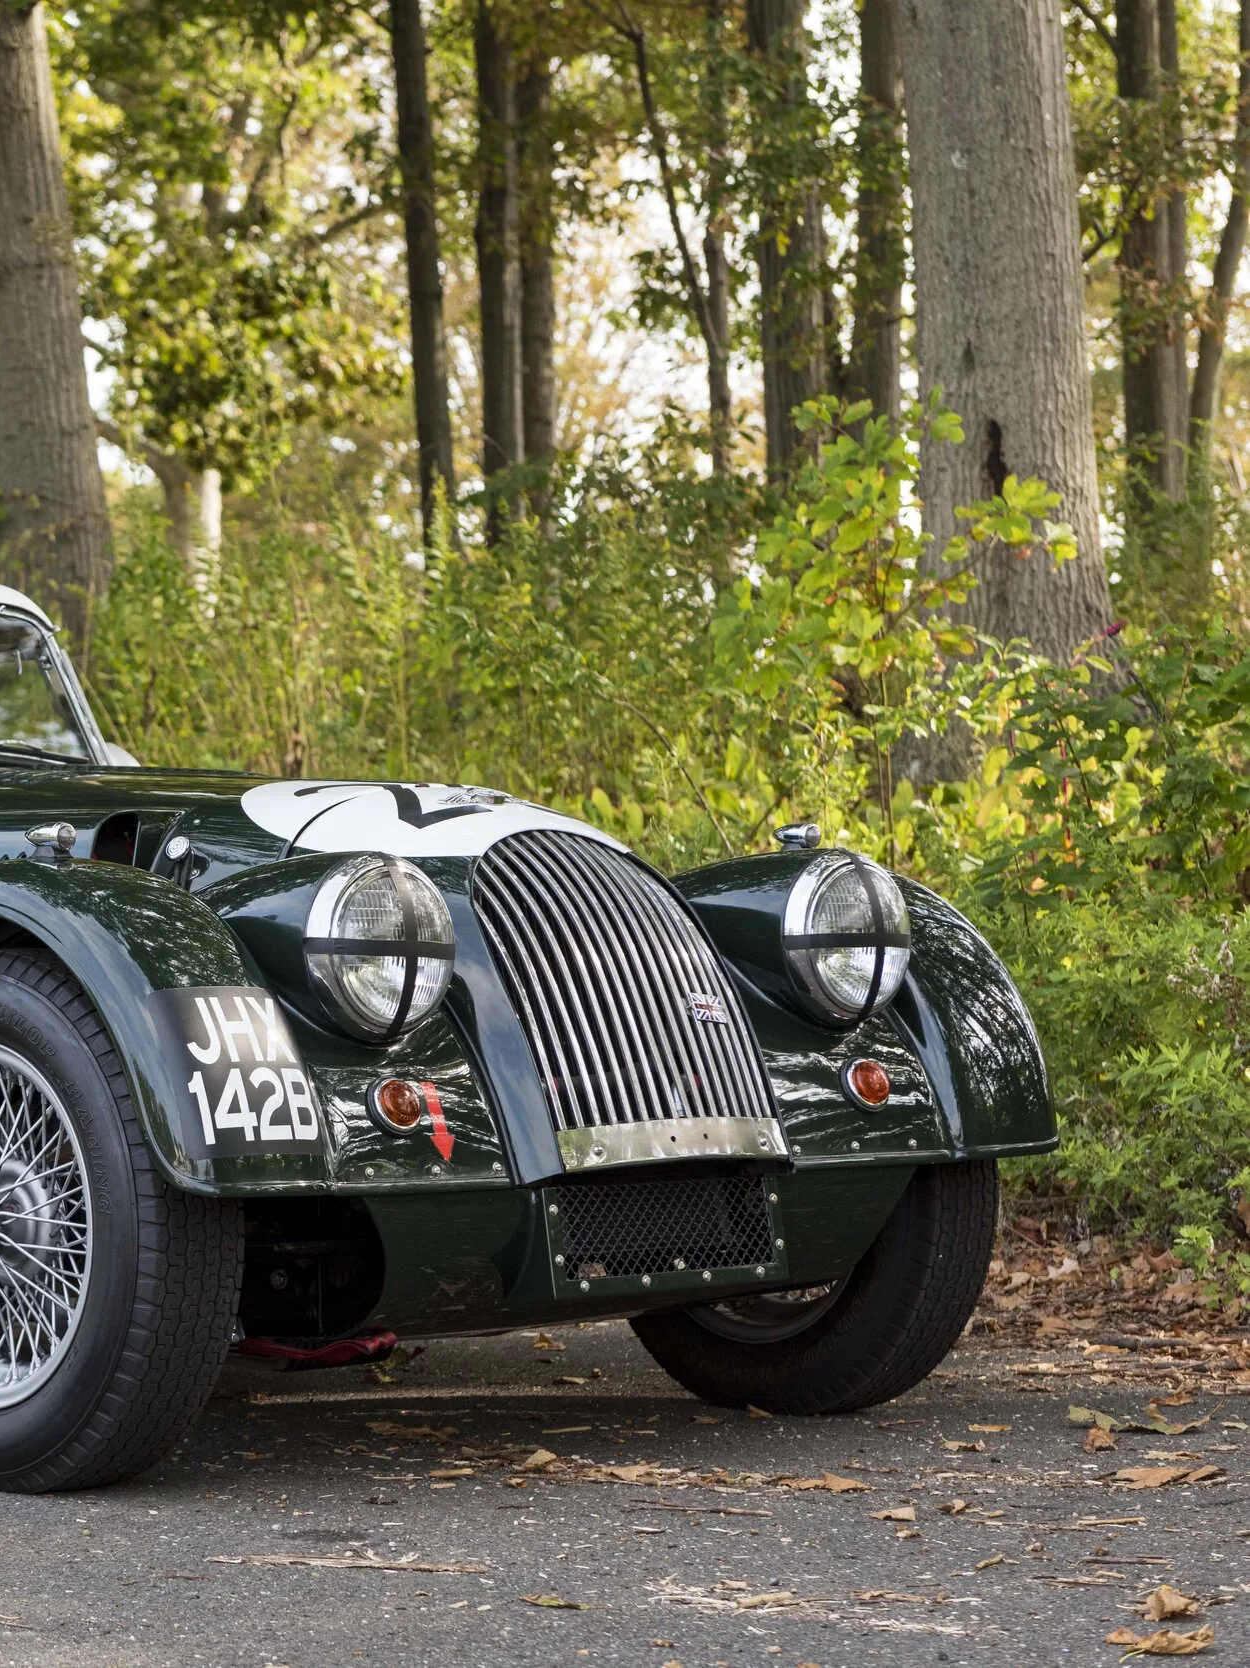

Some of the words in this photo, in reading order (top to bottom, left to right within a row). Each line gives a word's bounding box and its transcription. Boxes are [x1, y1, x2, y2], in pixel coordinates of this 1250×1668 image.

[186, 996, 297, 1064] JHX
[187, 1066, 318, 1145] 142B
[64, 1079, 114, 1216] RACING
